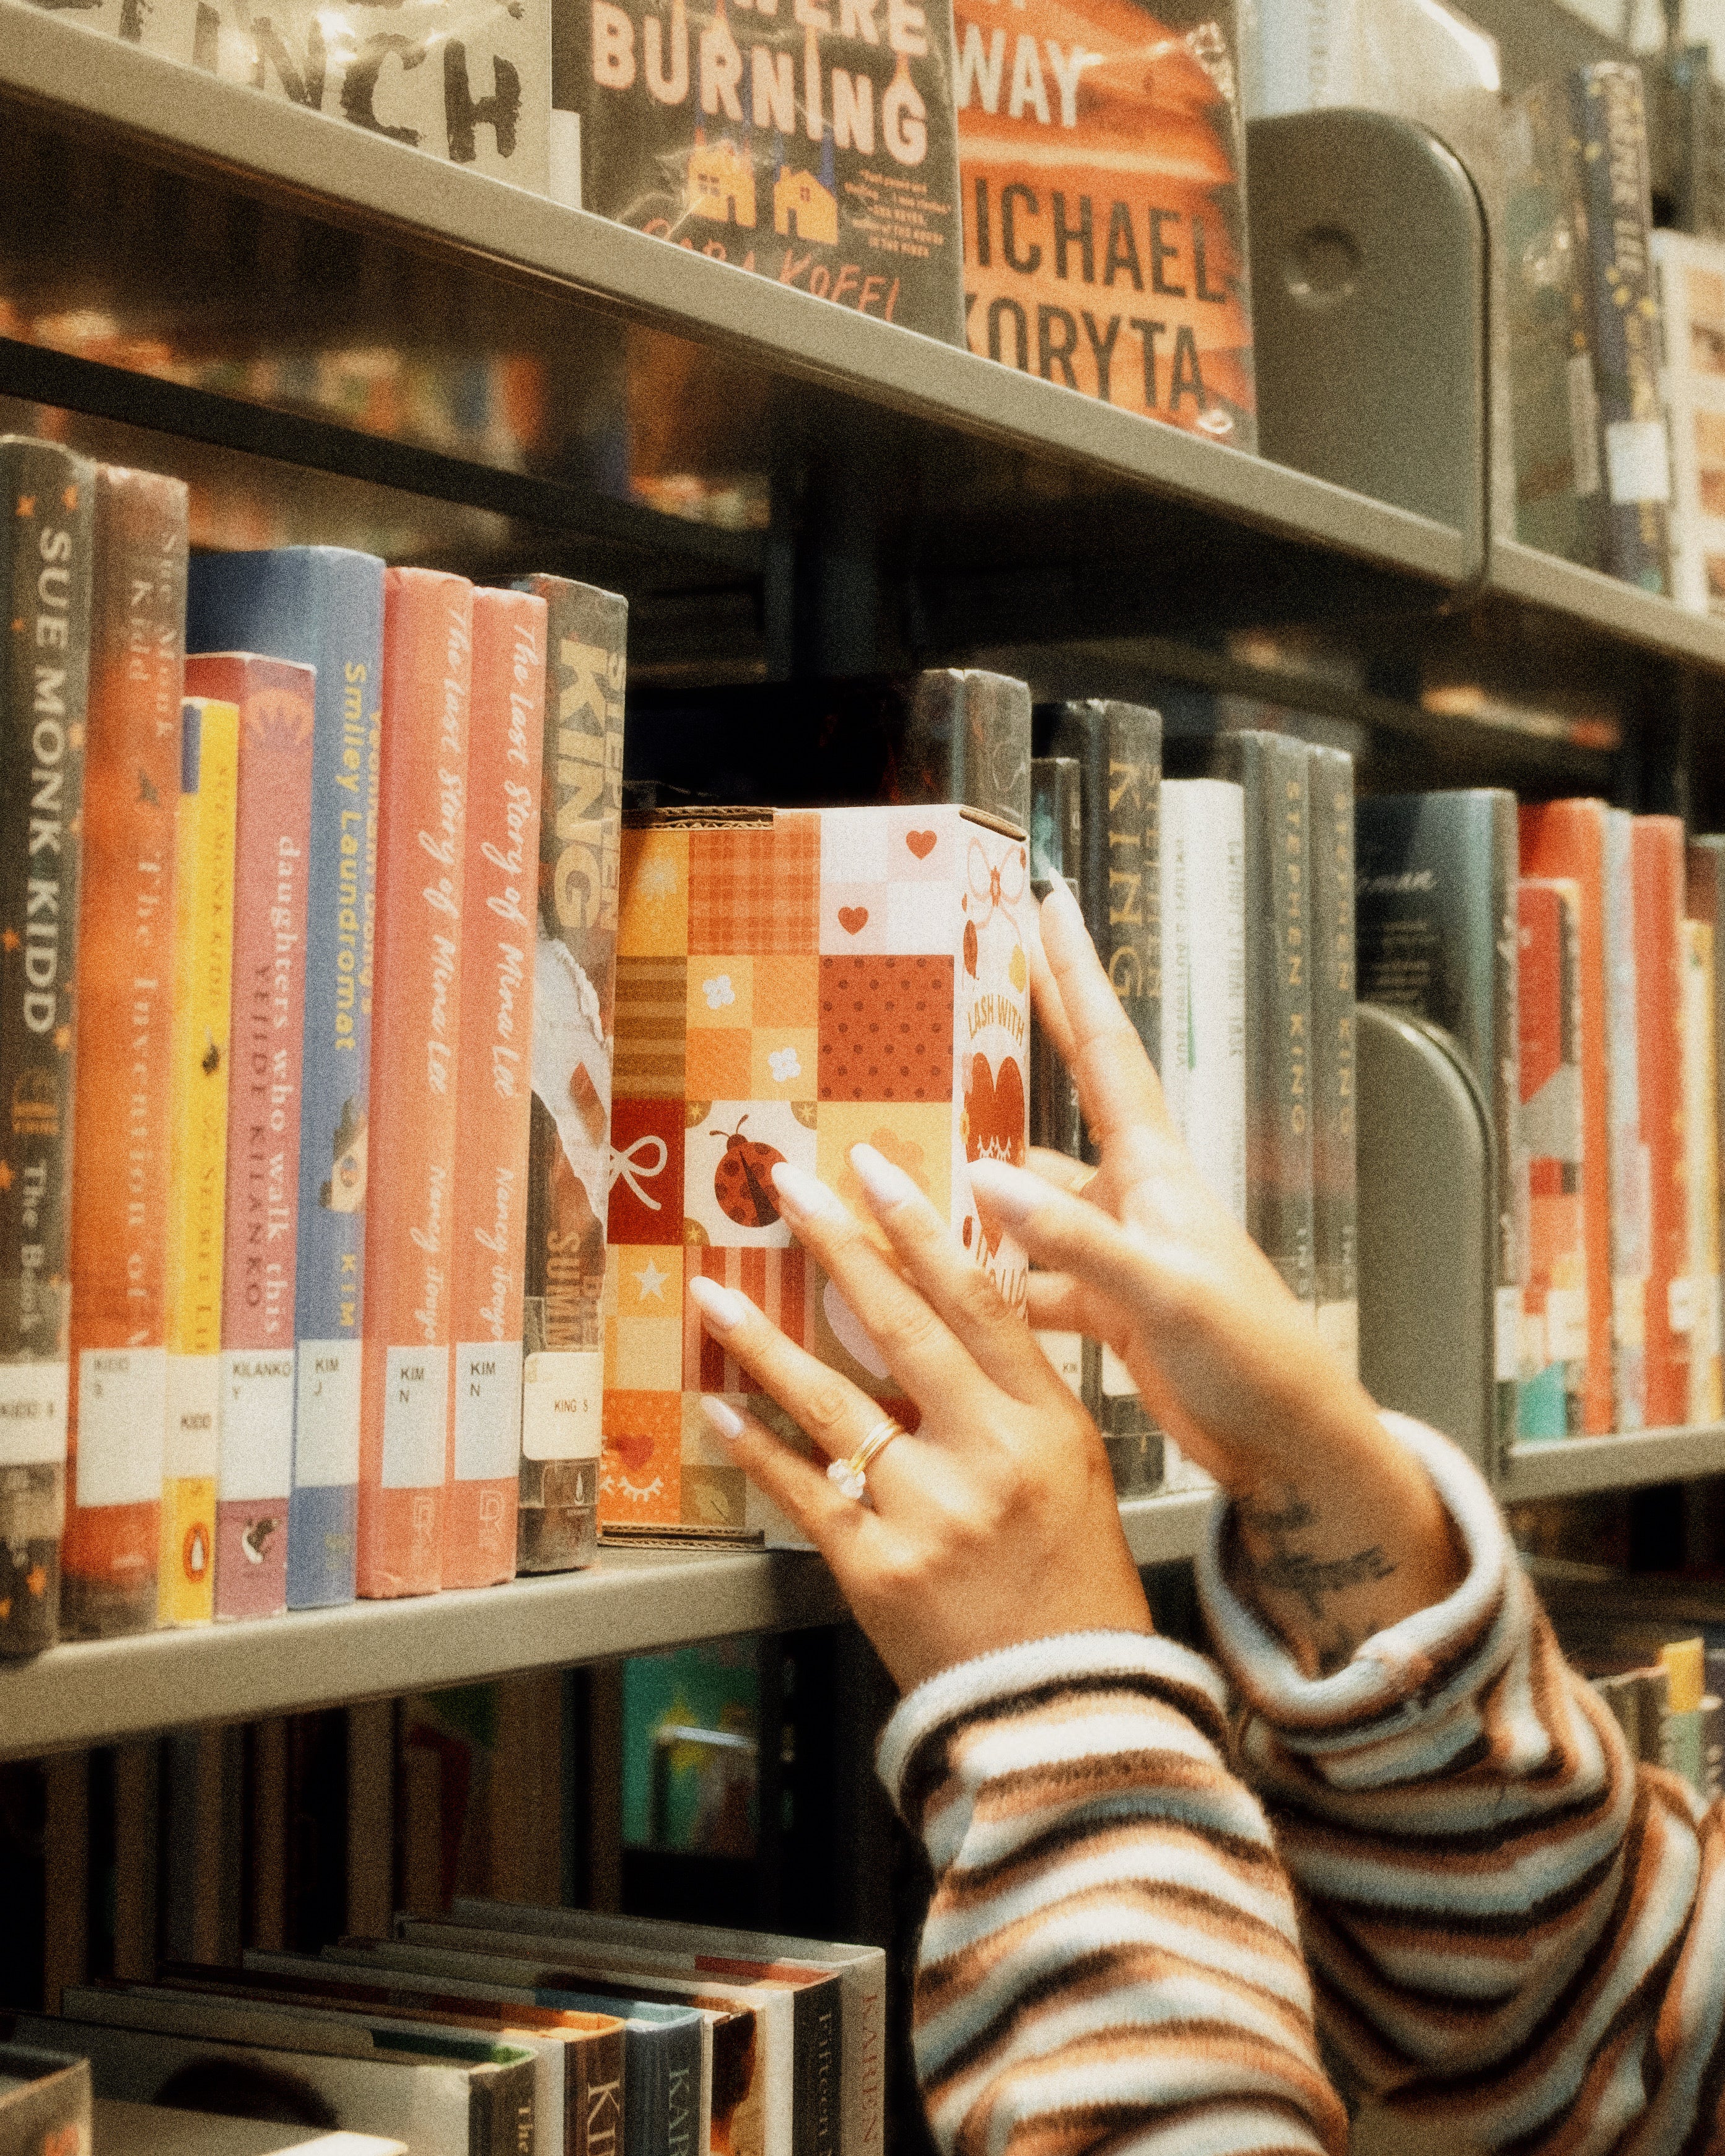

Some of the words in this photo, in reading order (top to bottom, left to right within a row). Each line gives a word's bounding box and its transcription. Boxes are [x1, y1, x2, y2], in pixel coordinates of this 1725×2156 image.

[592, 0, 927, 166] BURNING
[964, 178, 1226, 303] ICHAEL
[36, 527, 72, 648] SUE
[129, 578, 153, 681] Kidd
[446, 608, 469, 676] The
[513, 624, 539, 686] The
[29, 668, 65, 855] MONK
[336, 661, 367, 793] Smiley
[419, 768, 463, 865] Story
[554, 638, 608, 928] KING
[481, 780, 532, 876] Story
[422, 878, 460, 920] of
[486, 886, 528, 928] of
[1109, 759, 1142, 997] KING
[24, 879, 61, 1034] KIDD
[270, 836, 300, 1029] daughters
[335, 810, 361, 1050] Laundromat
[250, 965, 271, 1093] YEJIDE
[430, 935, 455, 1038] Mina
[497, 942, 525, 1041] Mina
[967, 993, 994, 1040] LASH
[997, 994, 1025, 1047] WITH
[129, 979, 158, 1226] Invention
[270, 1049, 294, 1132] who
[427, 1041, 451, 1094] Lee
[492, 1045, 522, 1099] Lee
[21, 1158, 48, 1229] The
[247, 1125, 264, 1307] KILANKO
[268, 1154, 292, 1239] walk
[410, 1166, 447, 1252] Nancy
[474, 1167, 513, 1252] Nancy
[264, 1263, 287, 1333] this
[339, 1253, 356, 1327] KIM
[232, 1361, 292, 1379] KILANKO
[400, 1366, 424, 1381] KIM
[400, 1389, 410, 1403] N
[469, 1361, 496, 1377] KIM
[469, 1384, 481, 1397] N
[554, 1398, 577, 1412] KING
[517, 2098, 533, 2153] The
